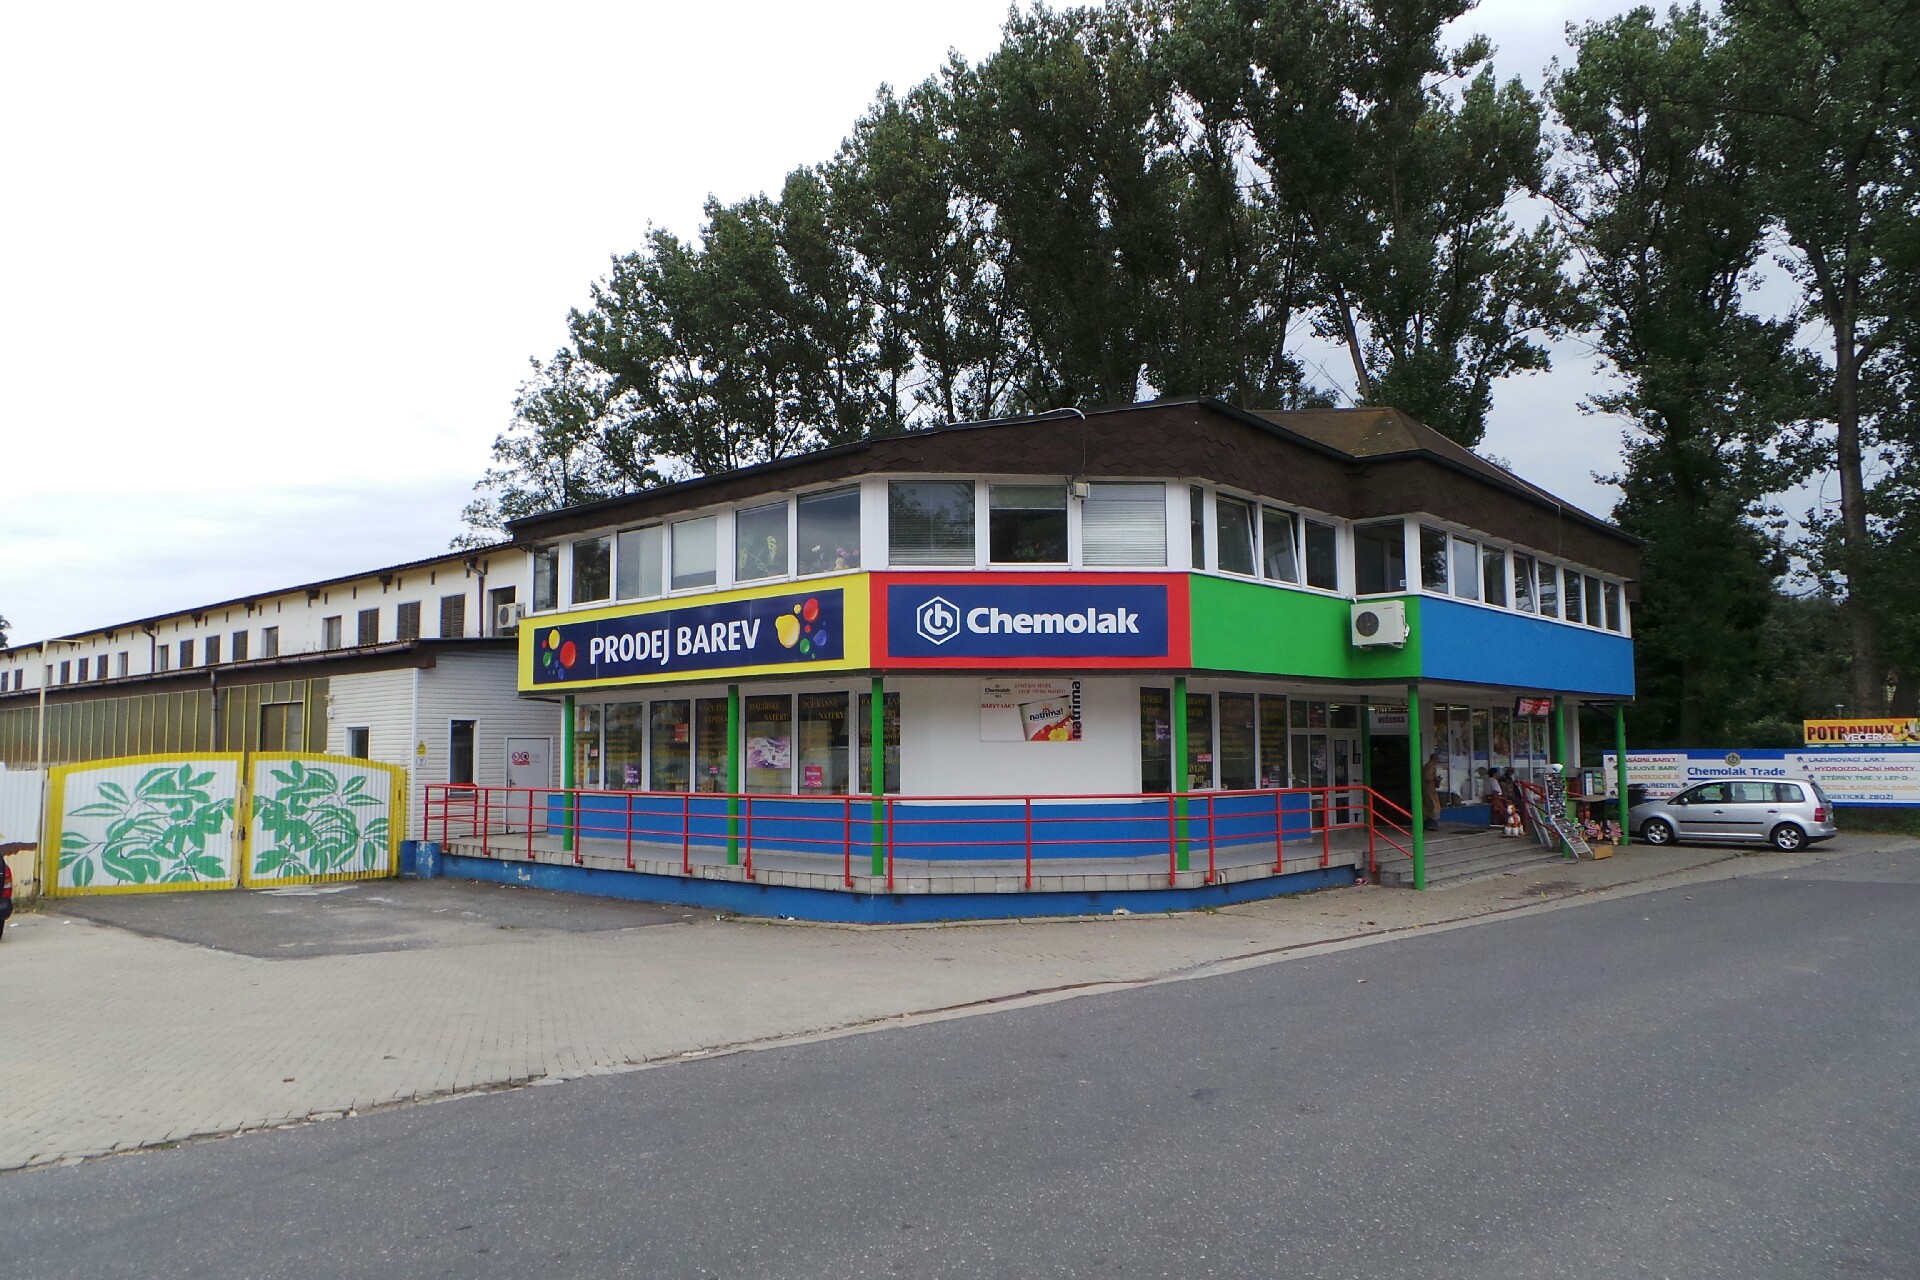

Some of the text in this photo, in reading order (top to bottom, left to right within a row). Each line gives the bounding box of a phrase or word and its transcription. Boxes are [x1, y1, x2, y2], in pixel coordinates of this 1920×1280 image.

[967, 607, 1140, 634] Chemolak
[589, 618, 761, 666] PRODEJ BAREV
[1068, 681, 1082, 739] natrima
[1807, 724, 1895, 741] POTRAVINY
[1842, 732, 1894, 741] VEČERKA
[1687, 767, 1786, 776] Chemolak Trade
